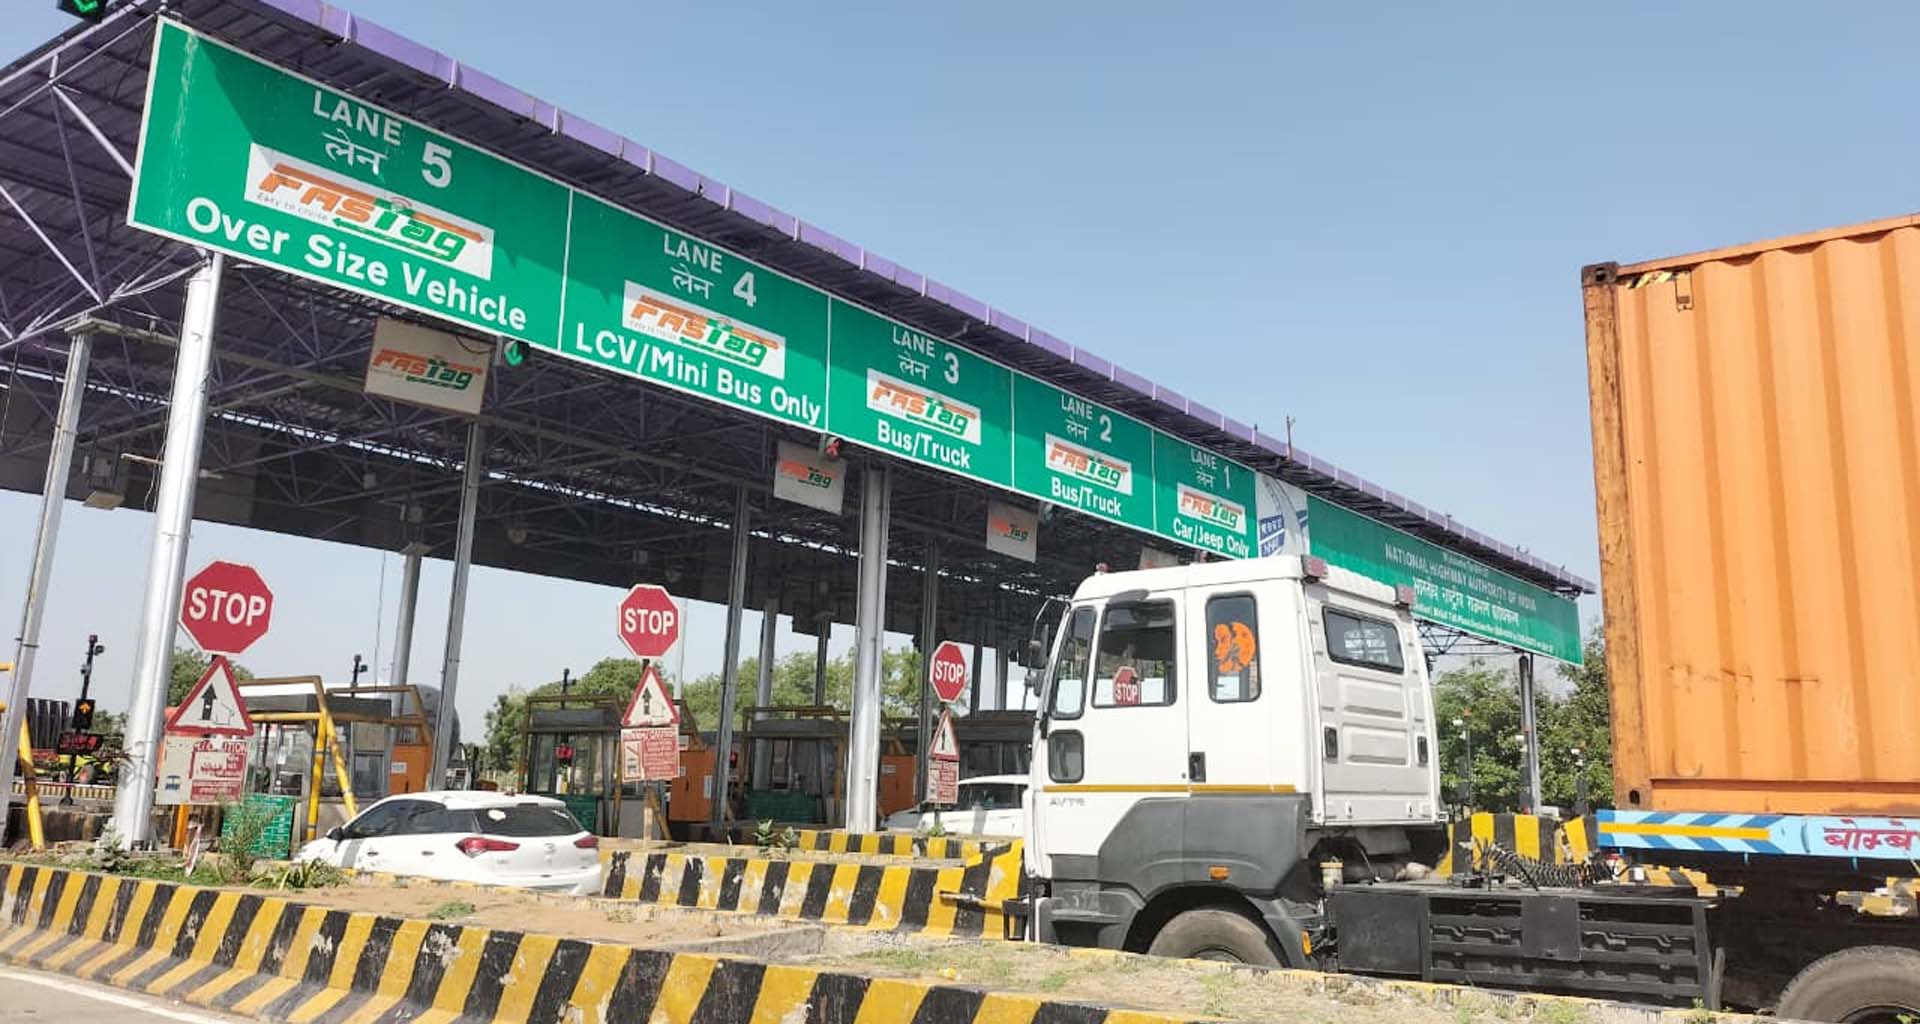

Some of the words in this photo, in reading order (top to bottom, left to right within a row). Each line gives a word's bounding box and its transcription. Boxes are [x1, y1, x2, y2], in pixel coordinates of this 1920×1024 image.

[312, 91, 402, 144] LANE
[421, 143, 453, 188] 5
[323, 130, 388, 175] लेन
[258, 163, 470, 263] FASTag
[185, 197, 291, 254] Over
[304, 233, 388, 287] Size
[402, 262, 527, 331] Vehicle
[663, 233, 723, 274] LANE
[733, 271, 757, 307] 4
[670, 263, 714, 299] लेन
[630, 295, 769, 367] FASTag
[893, 325, 936, 358] LANE
[943, 352, 960, 384] 3
[576, 322, 708, 388] LCV/Mini
[717, 367, 761, 403] Bus
[770, 386, 821, 425] Only
[898, 350, 930, 381] लेन
[872, 380, 969, 436] FASTag
[1061, 394, 1093, 420] LANE
[1099, 414, 1112, 443] 2
[1065, 415, 1089, 442] लेन
[878, 418, 971, 469] Bus/Truck
[1191, 448, 1217, 470] LANE
[1223, 465, 1231, 490] 1
[1051, 476, 1122, 516] Bus/Truck
[1173, 517, 1223, 550] Car/Jeep
[1226, 535, 1250, 559] Only
[1385, 543, 1427, 572] NATIONAL
[1429, 561, 1467, 587] HIGHWAY
[1468, 574, 1507, 600] AUTHORITY
[188, 587, 266, 627] STOP
[625, 608, 674, 635] STOP
[935, 660, 964, 684] STOP
[1115, 683, 1138, 704] STOP
